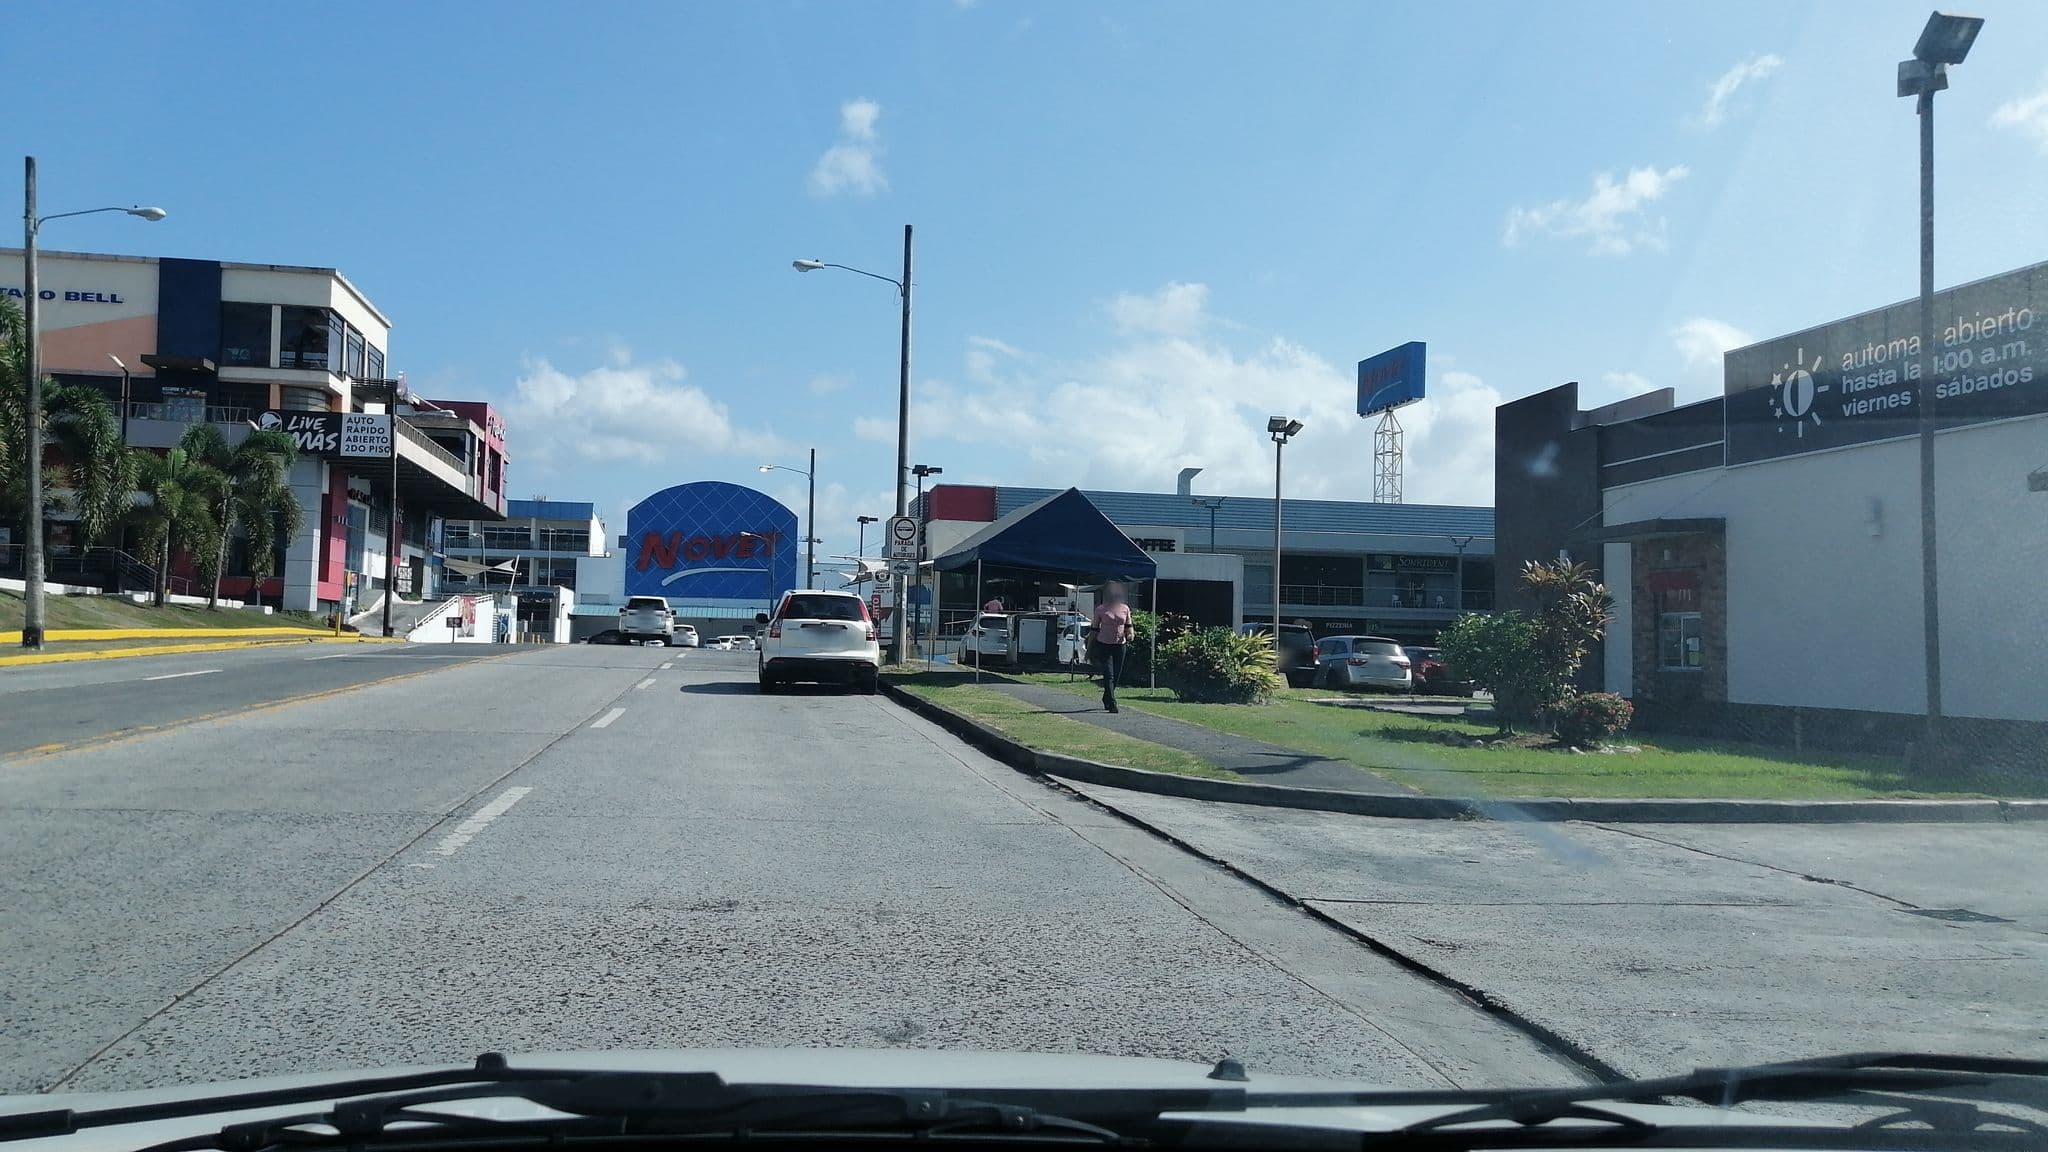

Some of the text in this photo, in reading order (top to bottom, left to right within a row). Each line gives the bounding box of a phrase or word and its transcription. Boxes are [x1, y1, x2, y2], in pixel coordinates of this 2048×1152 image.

[64, 291, 124, 304] BELL
[1842, 306, 2034, 372] automa abierto
[1842, 367, 1898, 395] hasta
[1903, 361, 1921, 384] la
[1980, 340, 2033, 366] a.m.
[1842, 389, 1912, 417] viernes
[1935, 364, 2034, 399] sábados
[346, 416, 375, 425] AUTO
[345, 435, 389, 444] ABIERTO
[344, 444, 366, 453] 2DO
[1129, 537, 1176, 552] OFFEE
